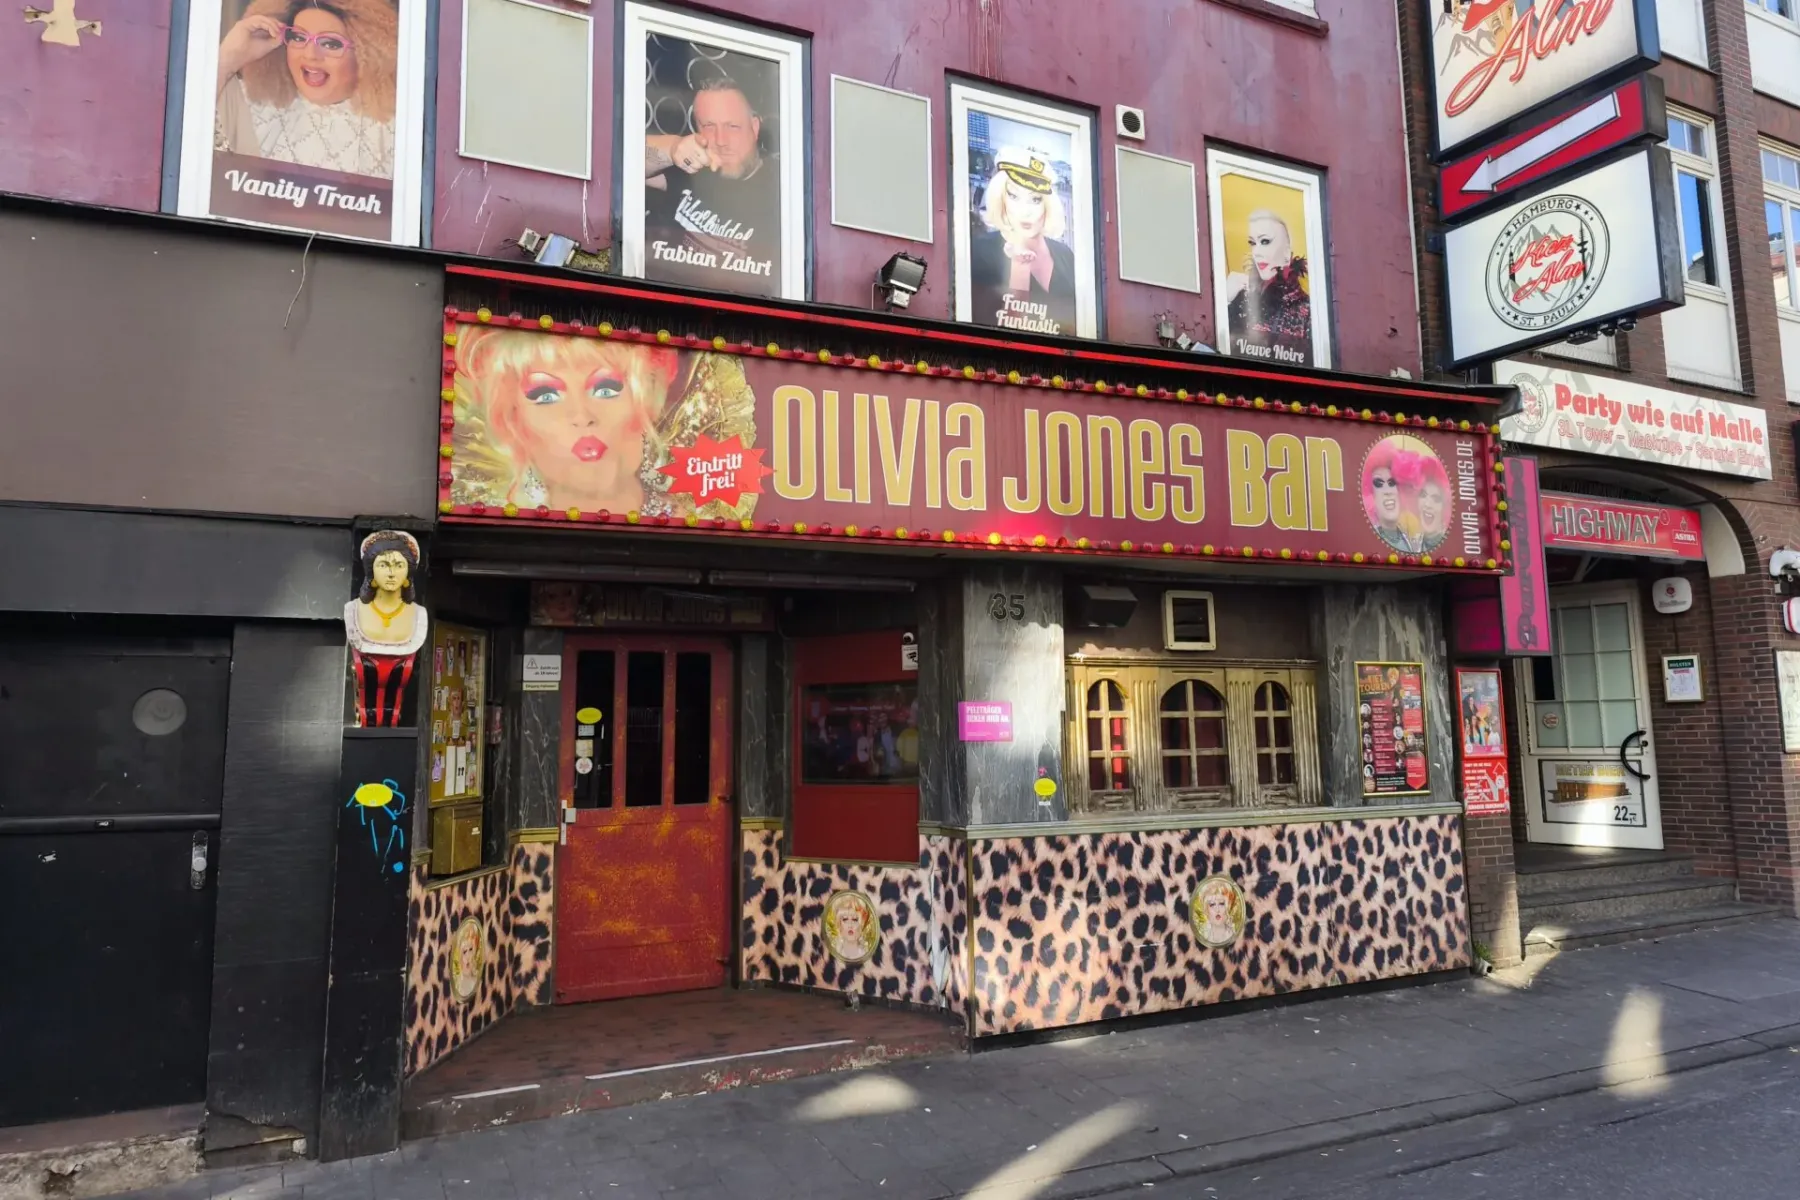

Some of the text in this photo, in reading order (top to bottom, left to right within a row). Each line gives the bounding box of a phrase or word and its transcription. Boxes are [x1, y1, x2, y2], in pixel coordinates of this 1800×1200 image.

[1444, 0, 1612, 117] Alm
[225, 169, 382, 215] Vanity Trash
[1512, 199, 1574, 230] HAMBURG
[652, 240, 773, 276] Fabian Zahrt
[1512, 248, 1586, 303] Alm
[1002, 293, 1048, 320] Fanny
[1519, 300, 1578, 326] ST. PAULI
[995, 310, 1061, 336] Funtastic
[1236, 338, 1305, 363] Veuve Noire
[1554, 383, 1621, 425] Party
[1627, 397, 1665, 428] wie
[1670, 408, 1704, 435] auf
[1707, 411, 1763, 446] Malle
[1576, 421, 1614, 444] Tower
[686, 453, 743, 476] Eintritt
[700, 471, 735, 497] frei!
[1456, 440, 1481, 555] OLIVIA-JONES.DE
[1551, 504, 1659, 545] HIGHWAY
[1674, 532, 1696, 543] ASTRA
[992, 592, 1025, 621] 35
